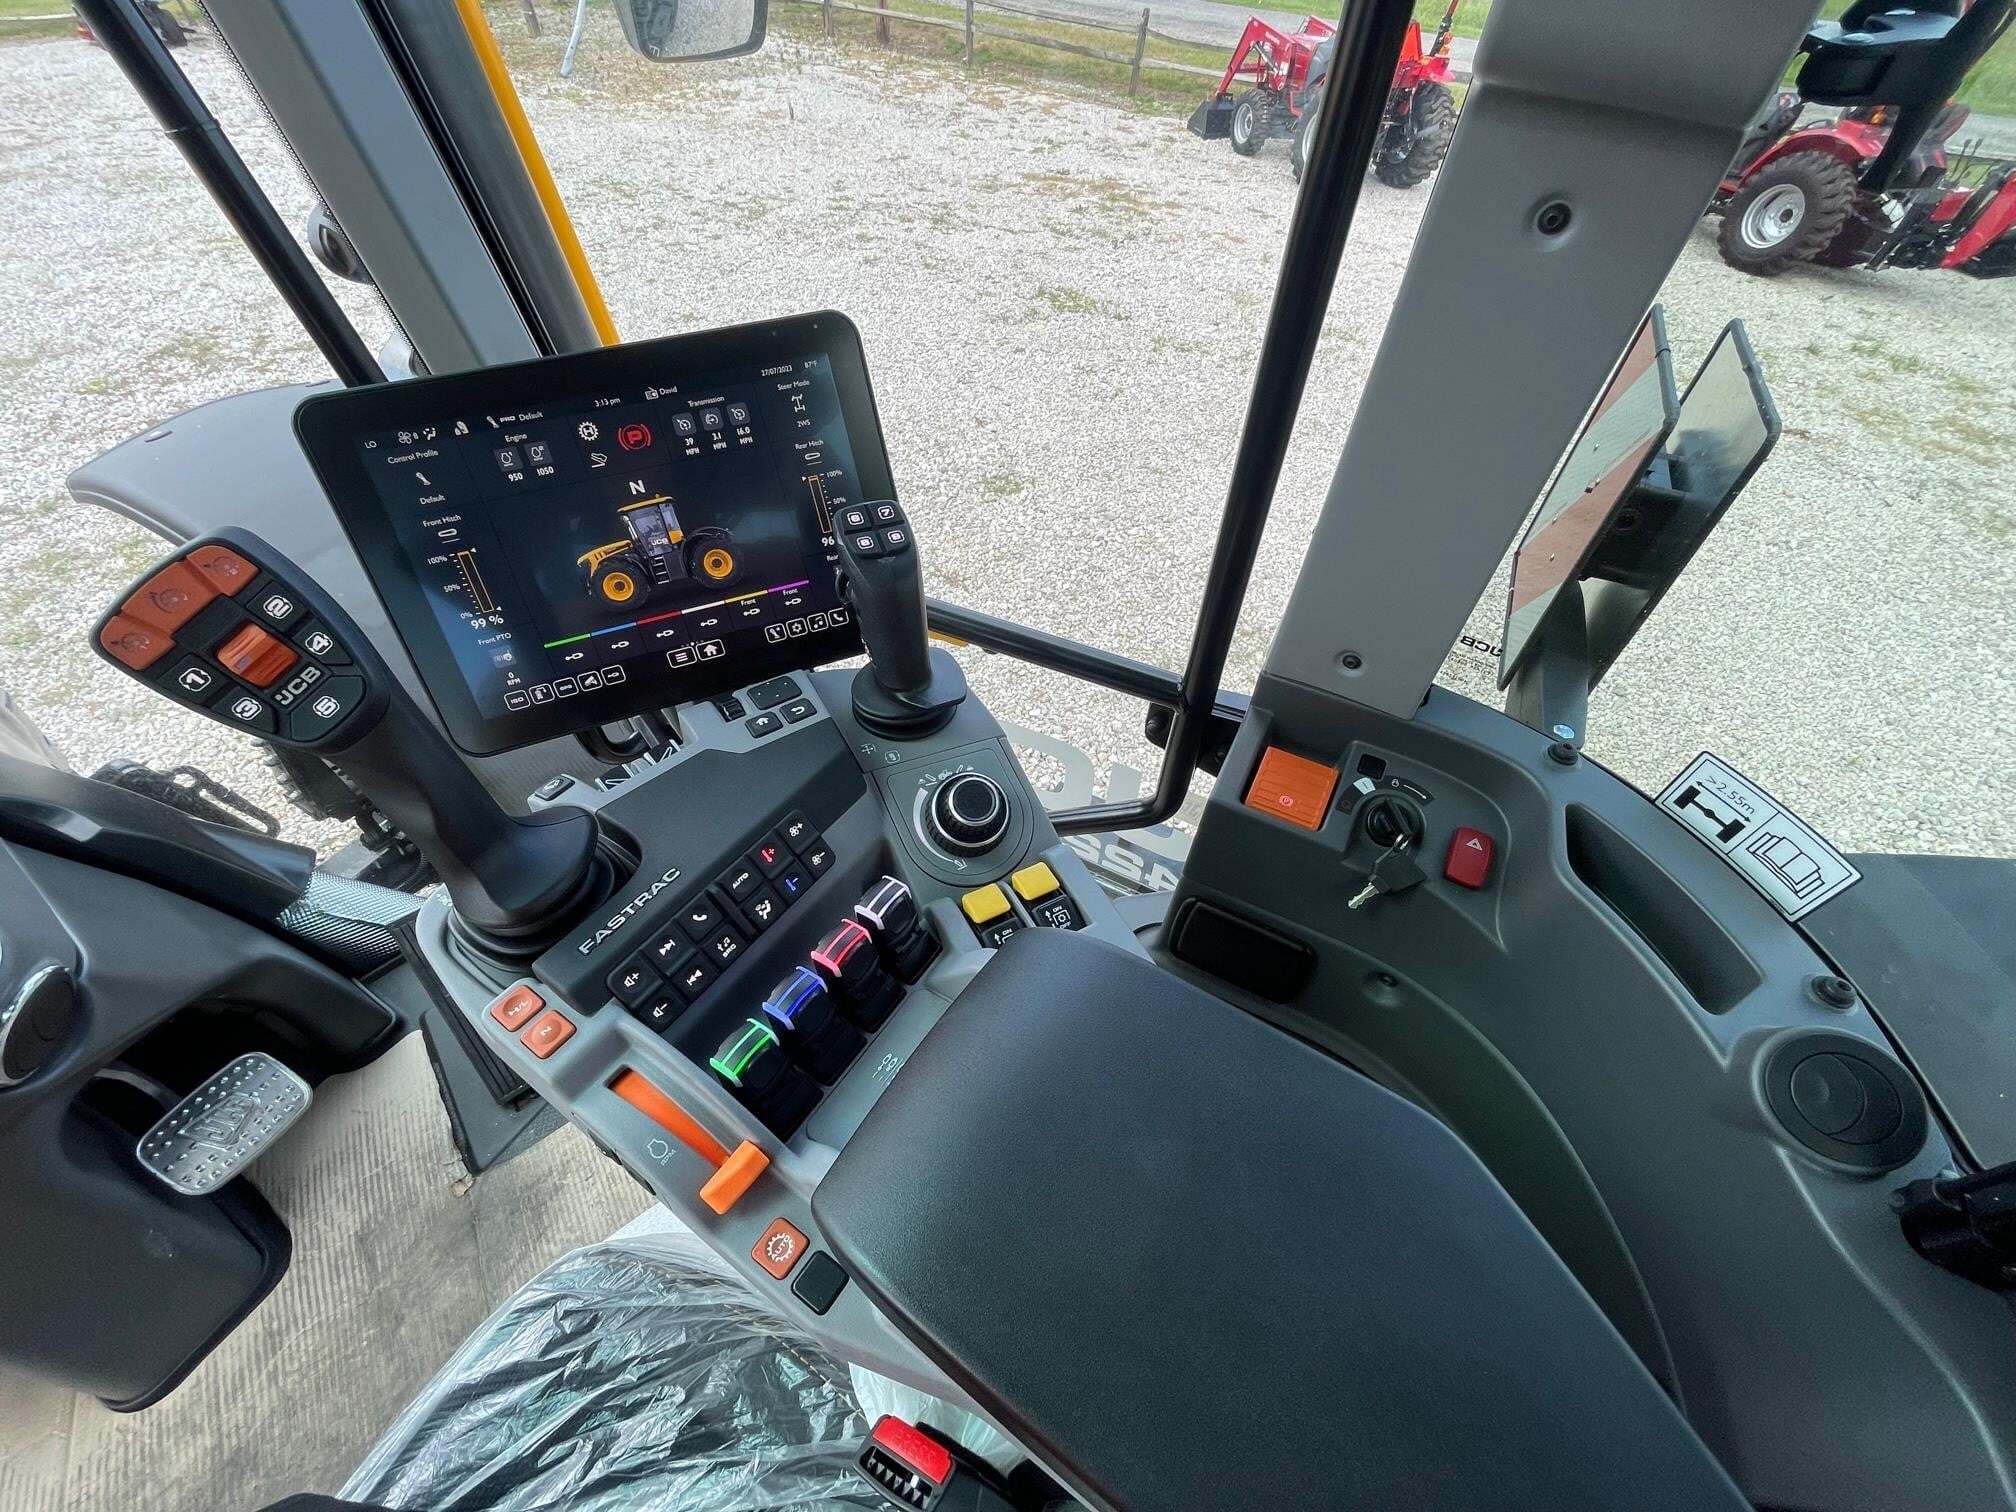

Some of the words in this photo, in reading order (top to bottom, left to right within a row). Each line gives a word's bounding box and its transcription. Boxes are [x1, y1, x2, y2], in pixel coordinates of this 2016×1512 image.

[659, 385, 678, 395] David
[595, 399, 609, 408] 3:13
[609, 398, 621, 407] pm
[687, 395, 725, 408] Transmission
[519, 411, 545, 422] Default
[736, 426, 751, 436] 16.0
[504, 432, 528, 443] Engine
[685, 437, 694, 446] 39
[711, 432, 722, 441] 3.1
[739, 436, 753, 445] MPH
[365, 440, 378, 449] LO
[712, 441, 727, 450] MPH
[795, 441, 809, 450] Rear
[685, 447, 700, 456] MPH
[387, 453, 415, 465] Control
[416, 449, 439, 459] Profile
[536, 466, 555, 477] 1050
[826, 469, 843, 479] 100%
[508, 472, 523, 482] 950
[629, 479, 646, 495] N
[419, 494, 446, 505] Default
[833, 497, 846, 505] 50%
[422, 516, 442, 528] Front
[442, 514, 462, 525] Hitch
[821, 536, 835, 547] 96
[426, 554, 448, 566] 100%
[443, 583, 461, 593] 50%
[782, 587, 799, 596] Front
[740, 598, 757, 608] Front
[460, 612, 474, 620] 0%
[470, 618, 487, 630] 99
[488, 614, 505, 626] %
[477, 635, 496, 646] Front
[496, 632, 512, 642] PTO
[274, 667, 321, 705] JCB
[506, 677, 521, 686] RPM
[511, 696, 524, 704] ISO
[731, 871, 749, 891] AUTO
[577, 866, 684, 956] FASTRAC
[1052, 904, 1063, 913] ON
[1002, 927, 1013, 936] ON
[722, 942, 737, 958] SRC
[660, 1147, 677, 1167] RPM
[771, 1234, 791, 1261] AUTO
